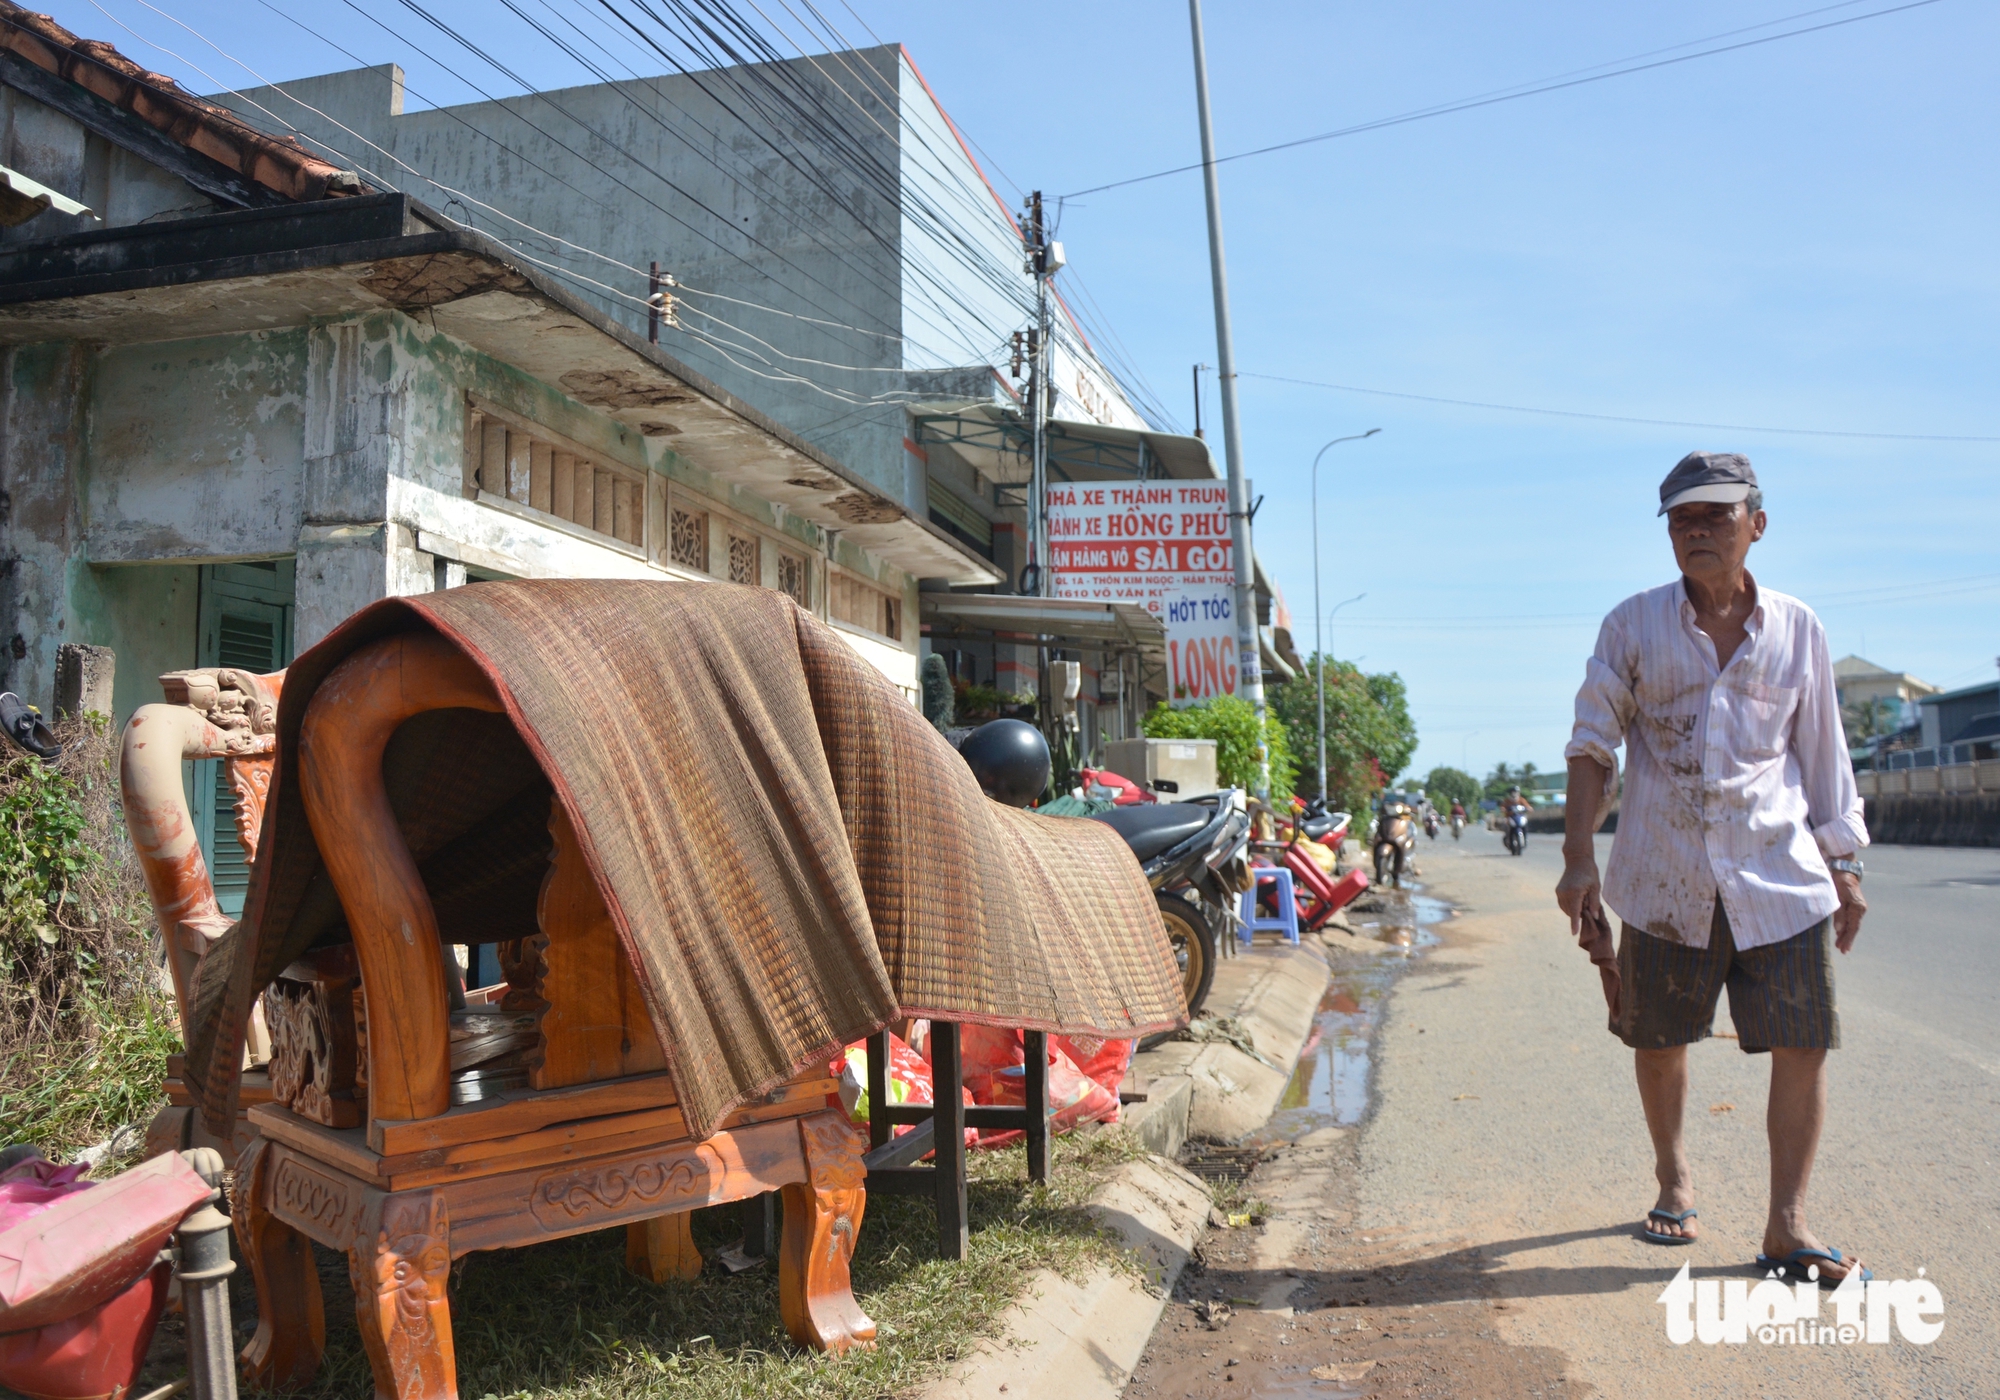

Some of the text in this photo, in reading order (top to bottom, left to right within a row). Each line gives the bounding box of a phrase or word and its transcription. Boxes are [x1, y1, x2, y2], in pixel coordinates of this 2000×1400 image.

[1083, 490, 1105, 505] XE
[1110, 485, 1172, 505] THÀNH
[1178, 488, 1230, 504] TRUN
[1085, 517, 1102, 536] XE
[1107, 505, 1174, 537] HỒNG
[1073, 546, 1108, 567] HÀNG
[1111, 547, 1129, 567] VÔ
[1134, 540, 1179, 571] SÀI
[1055, 577, 1068, 585] QL
[1072, 577, 1084, 585] 1A
[1093, 574, 1120, 585] THÔN
[1123, 576, 1143, 585] KIM
[1145, 575, 1174, 587] NGỌC
[1183, 573, 1206, 584] HÀM
[1058, 589, 1088, 598] 1610
[1093, 587, 1111, 598] VÕ
[1202, 593, 1230, 619] TÓC
[1170, 635, 1236, 698] LONG
